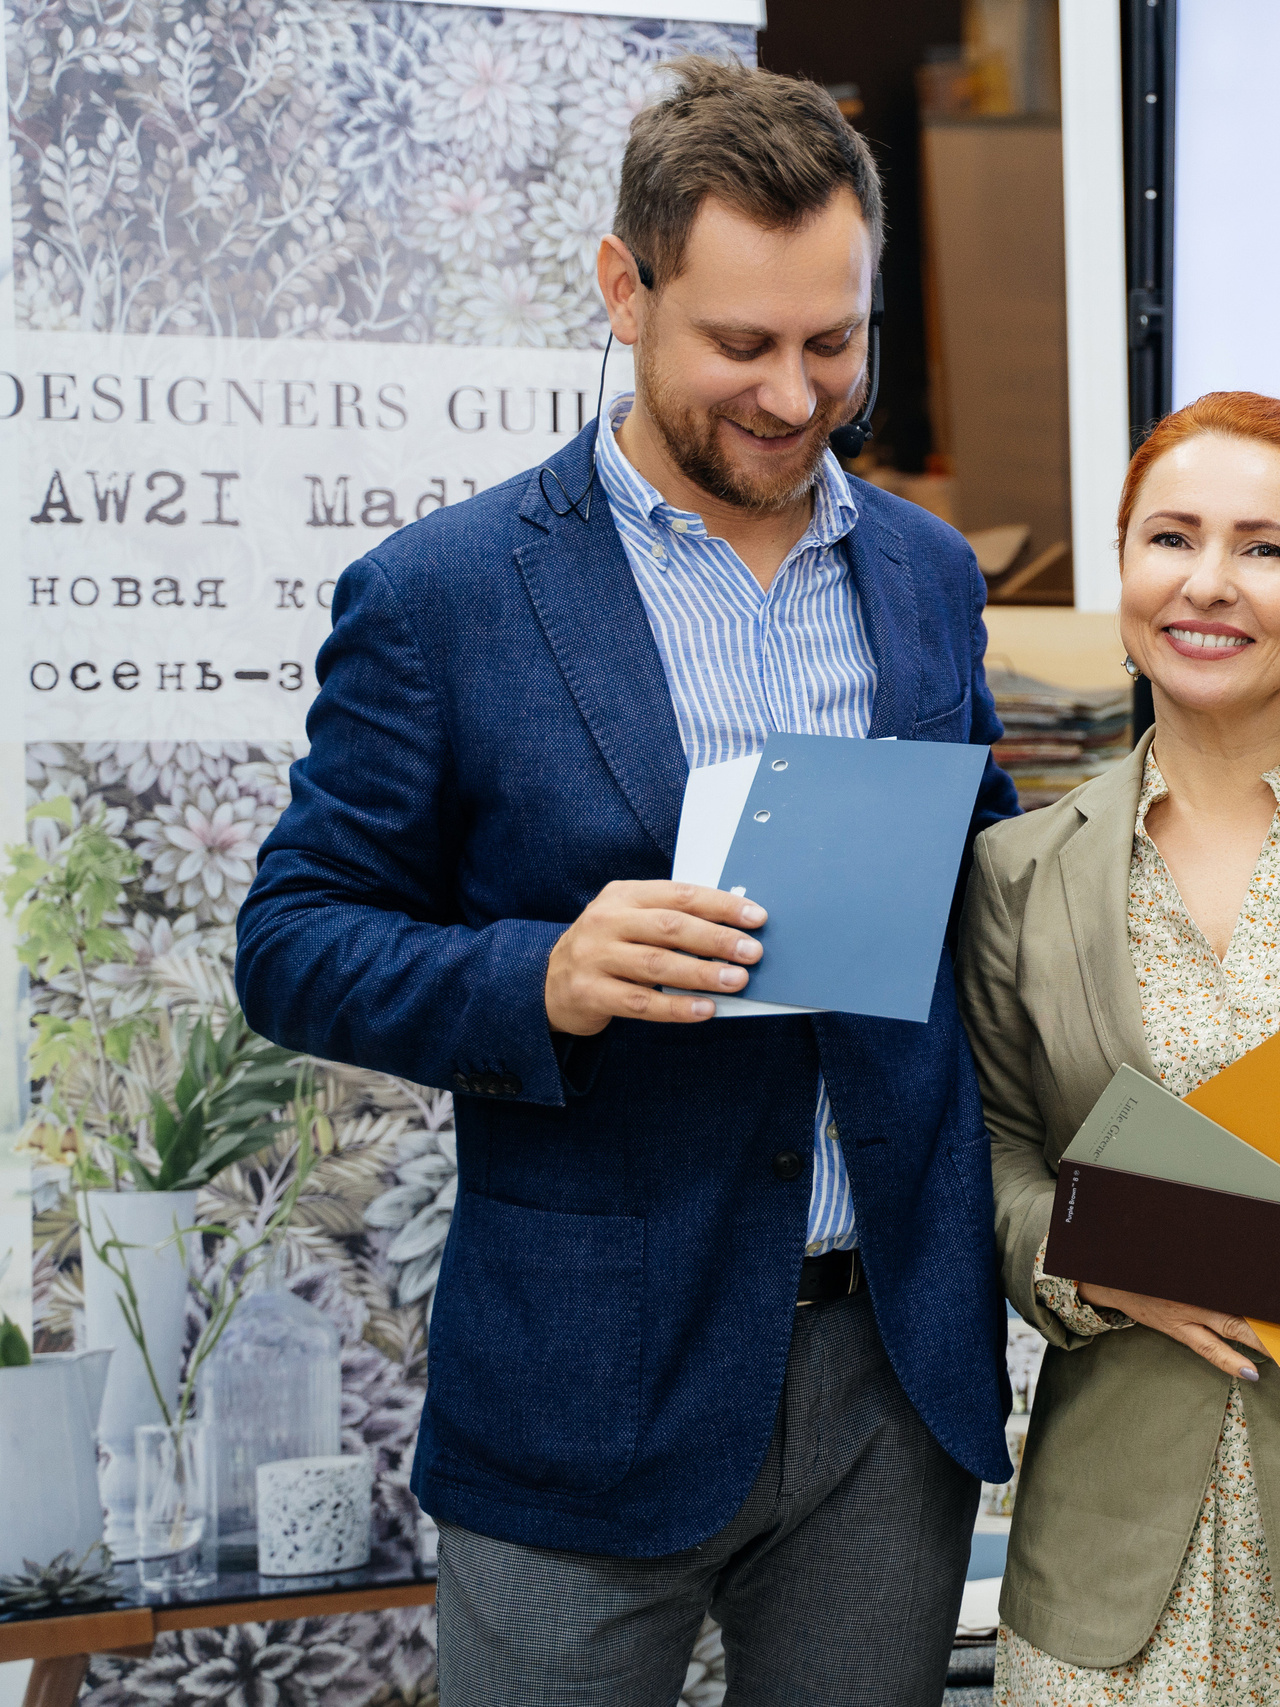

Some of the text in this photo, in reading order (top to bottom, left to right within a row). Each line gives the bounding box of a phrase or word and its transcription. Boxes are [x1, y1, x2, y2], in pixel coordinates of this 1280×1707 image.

[0, 370, 410, 433] DESIGNERS
[28, 576, 228, 609] новая
[1116, 1097, 1138, 1123] Little
[1065, 1205, 1075, 1223] Purple
